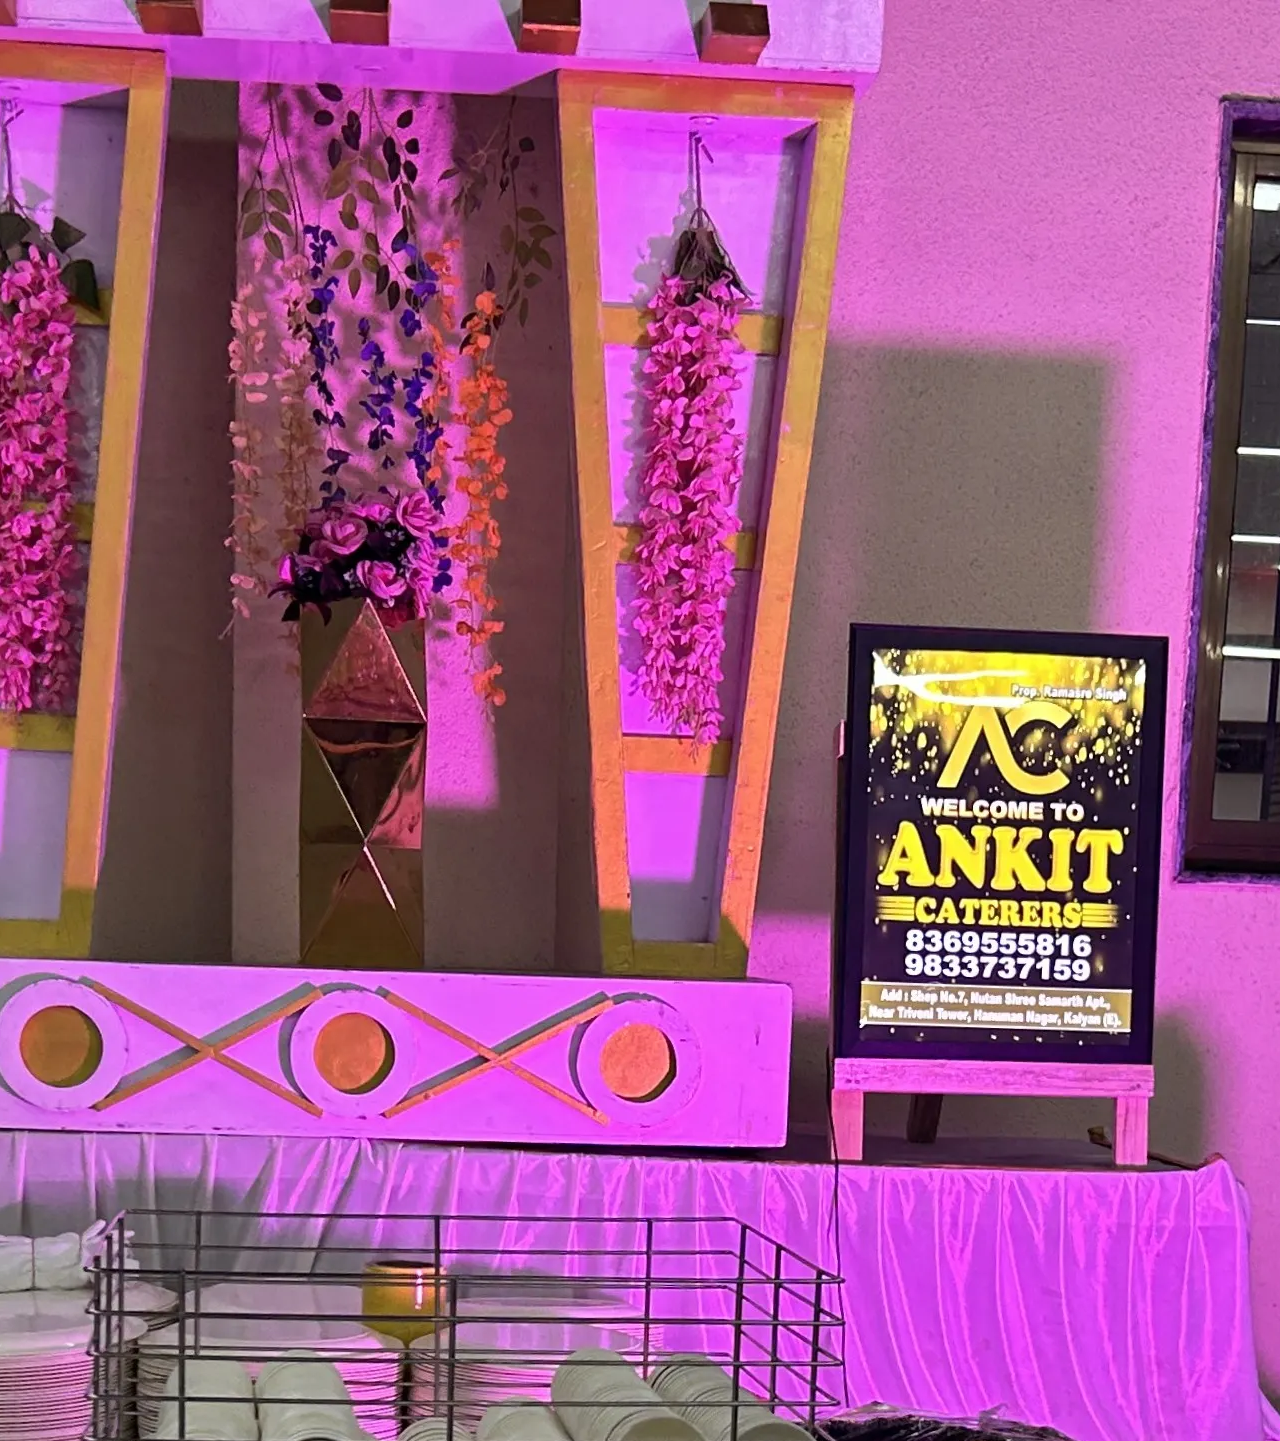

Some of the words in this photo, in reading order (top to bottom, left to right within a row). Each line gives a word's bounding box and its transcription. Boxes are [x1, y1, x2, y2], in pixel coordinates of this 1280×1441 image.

[1011, 683, 1039, 699] Prop.
[1095, 687, 1127, 702] Singh
[921, 797, 1044, 820] WELCOME
[1050, 803, 1085, 821] TO
[877, 820, 1124, 893] ANKIT
[915, 897, 1083, 928] CATERERS
[905, 930, 1092, 956] 8369555816
[904, 954, 1091, 980] 9833737159
[1063, 1013, 1101, 1028] Kalyan
